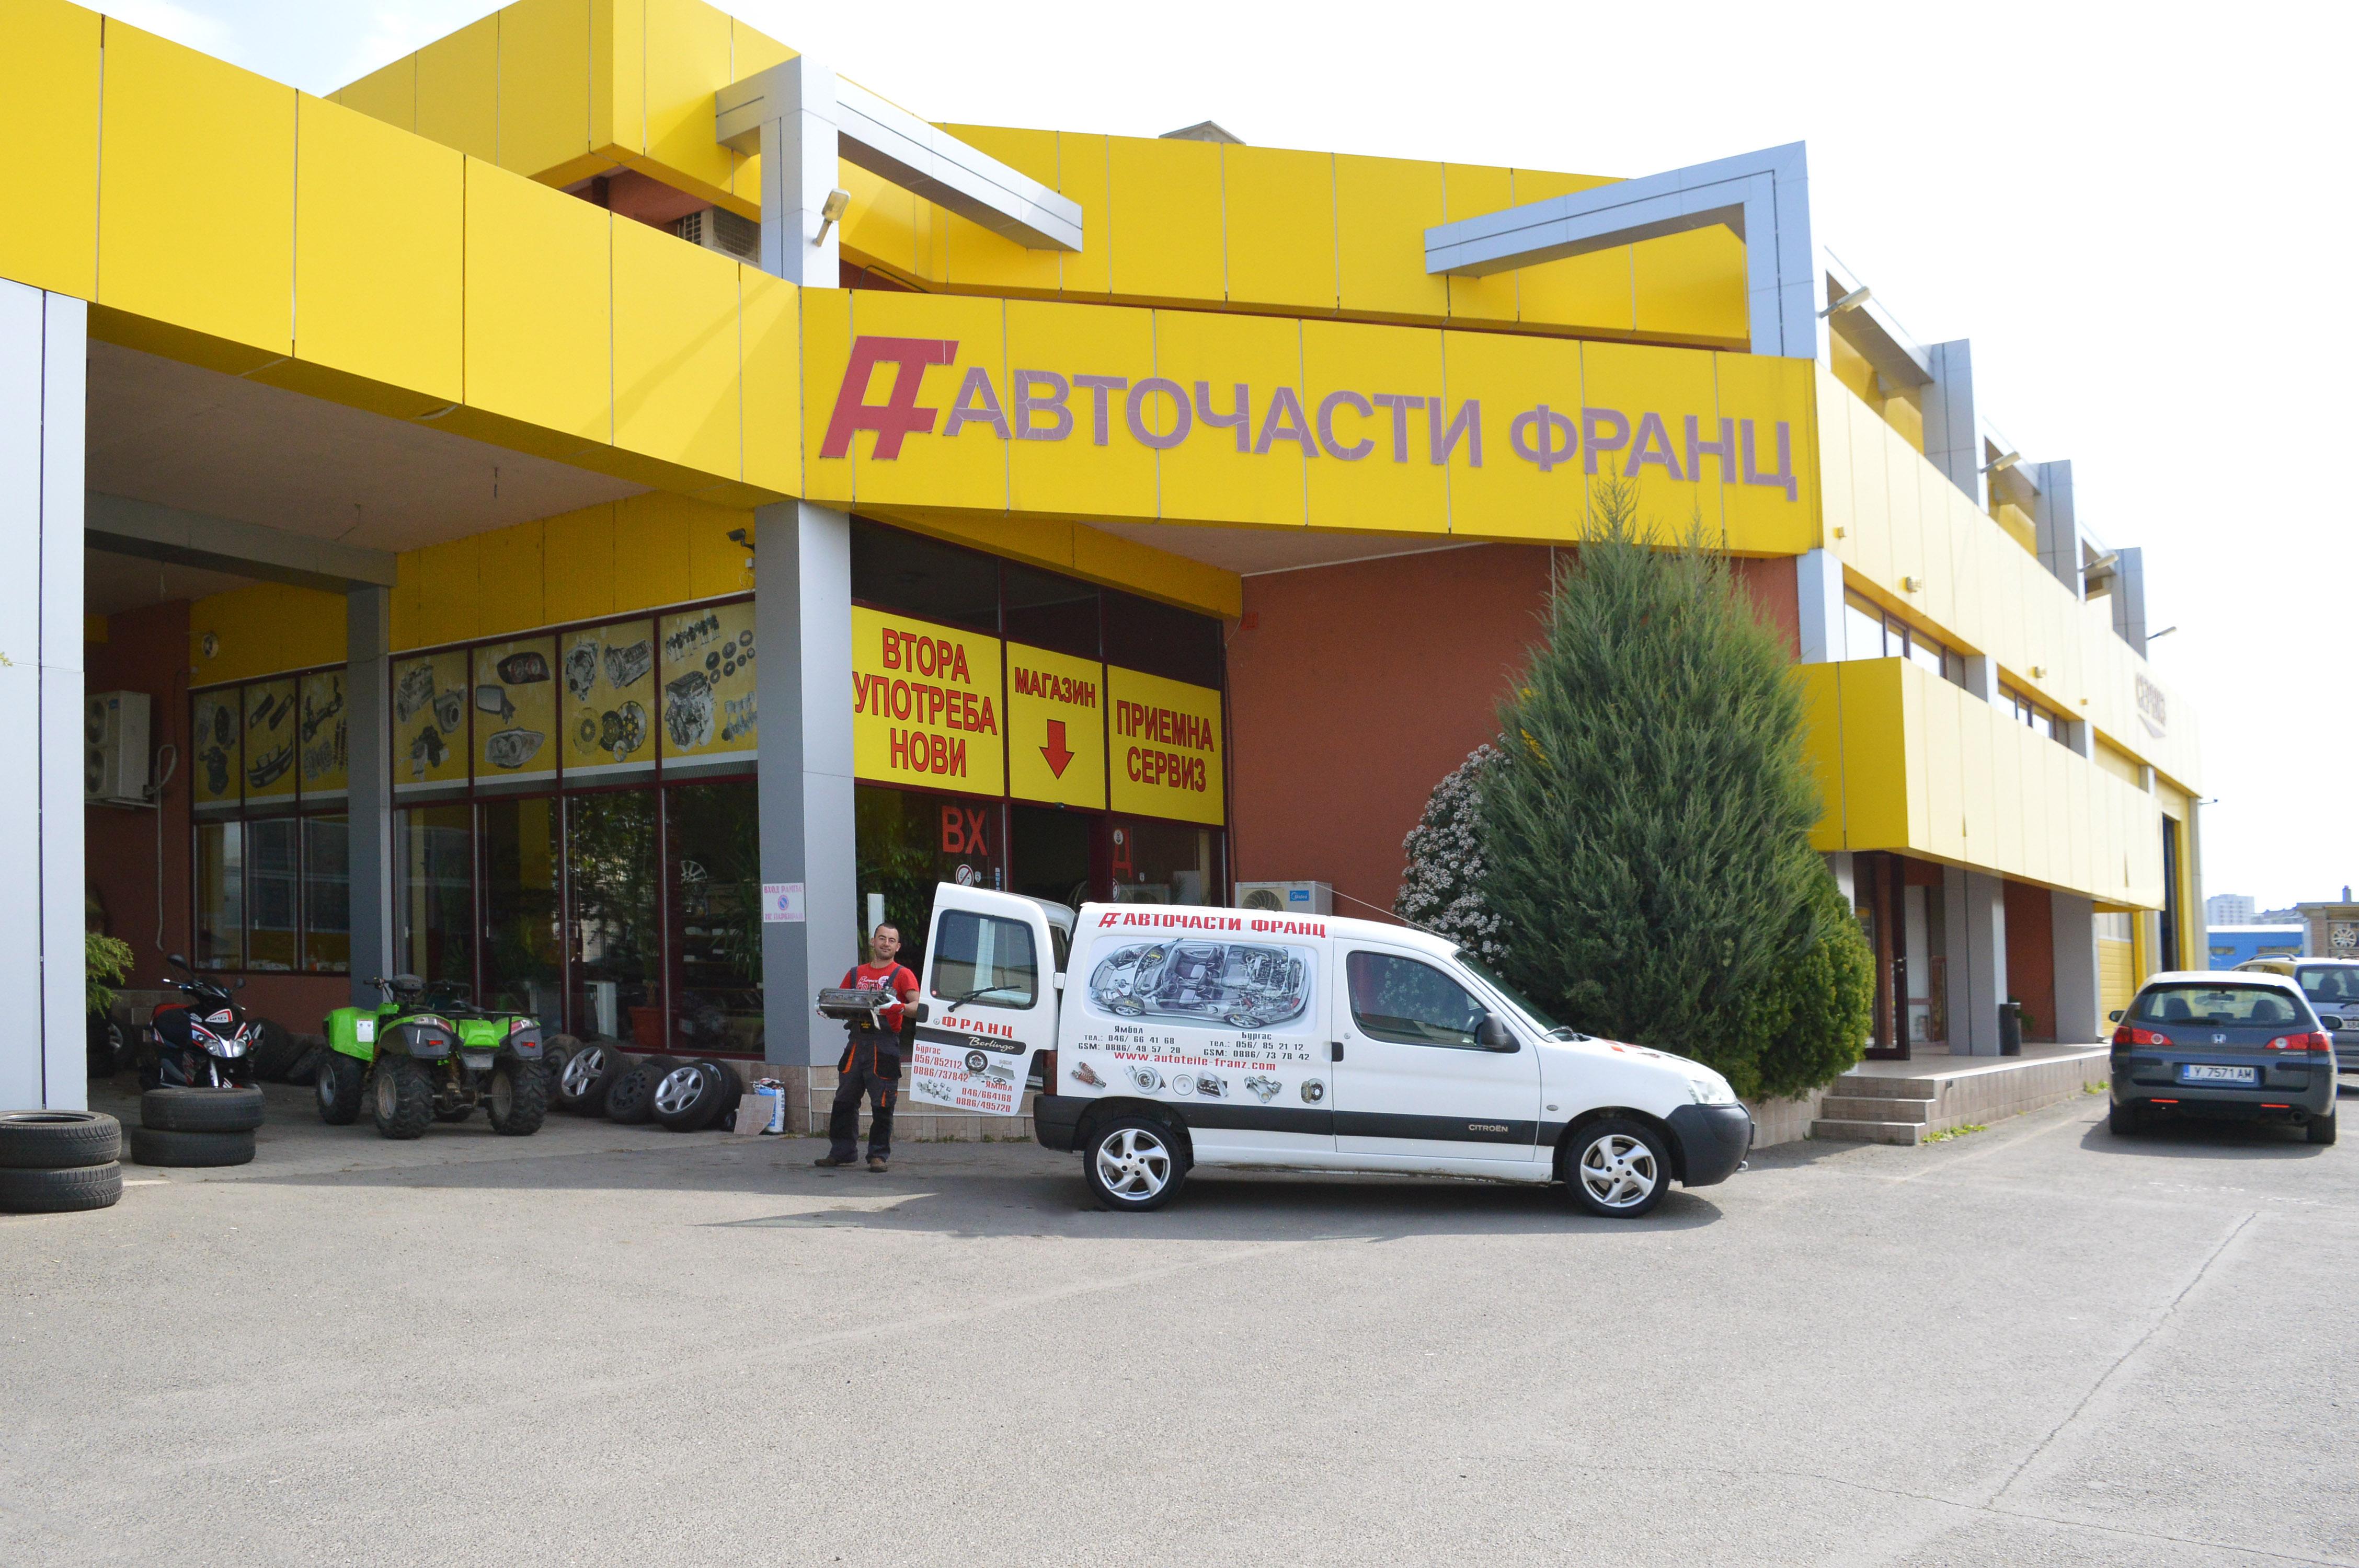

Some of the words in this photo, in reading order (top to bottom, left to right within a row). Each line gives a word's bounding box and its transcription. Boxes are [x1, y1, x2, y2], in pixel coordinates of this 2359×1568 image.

[942, 366, 1483, 469] АВТОЧАСТИ
[1509, 403, 1798, 502] ФРАНЦ
[881, 627, 971, 684] ВТОРА
[1014, 667, 1096, 709] МАГАЗИН
[851, 671, 998, 736] УПОТРЕБА
[1116, 699, 1215, 753] ПРИЕМНА
[889, 728, 967, 778] НОВИ
[1126, 746, 1207, 793] СЕРВИЗ
[941, 805, 988, 856] ВХ
[1123, 913, 1241, 931] АВТОЧАСТИ
[1251, 919, 1326, 938] ФРАНЦ
[942, 1016, 1013, 1039] ФРАНЦ
[1114, 1025, 1143, 1034] Ямбол
[968, 1036, 1015, 1052] Berlingo
[1241, 1032, 1272, 1041] Бургас
[915, 1044, 941, 1055] Бургас
[1105, 1043, 1130, 1052] 0886/
[1233, 1050, 1260, 1059] 0886/
[915, 1054, 962, 1070] 056/852112
[1114, 1052, 1276, 1071] www.autoteile-franz.com
[913, 1065, 969, 1082] 0886/737842
[2207, 1067, 2235, 1078] 7571
[961, 1087, 1012, 1102] 046/664168
[956, 1097, 1011, 1113] 0886/495720
[1468, 1124, 1508, 1132] CITROËN
